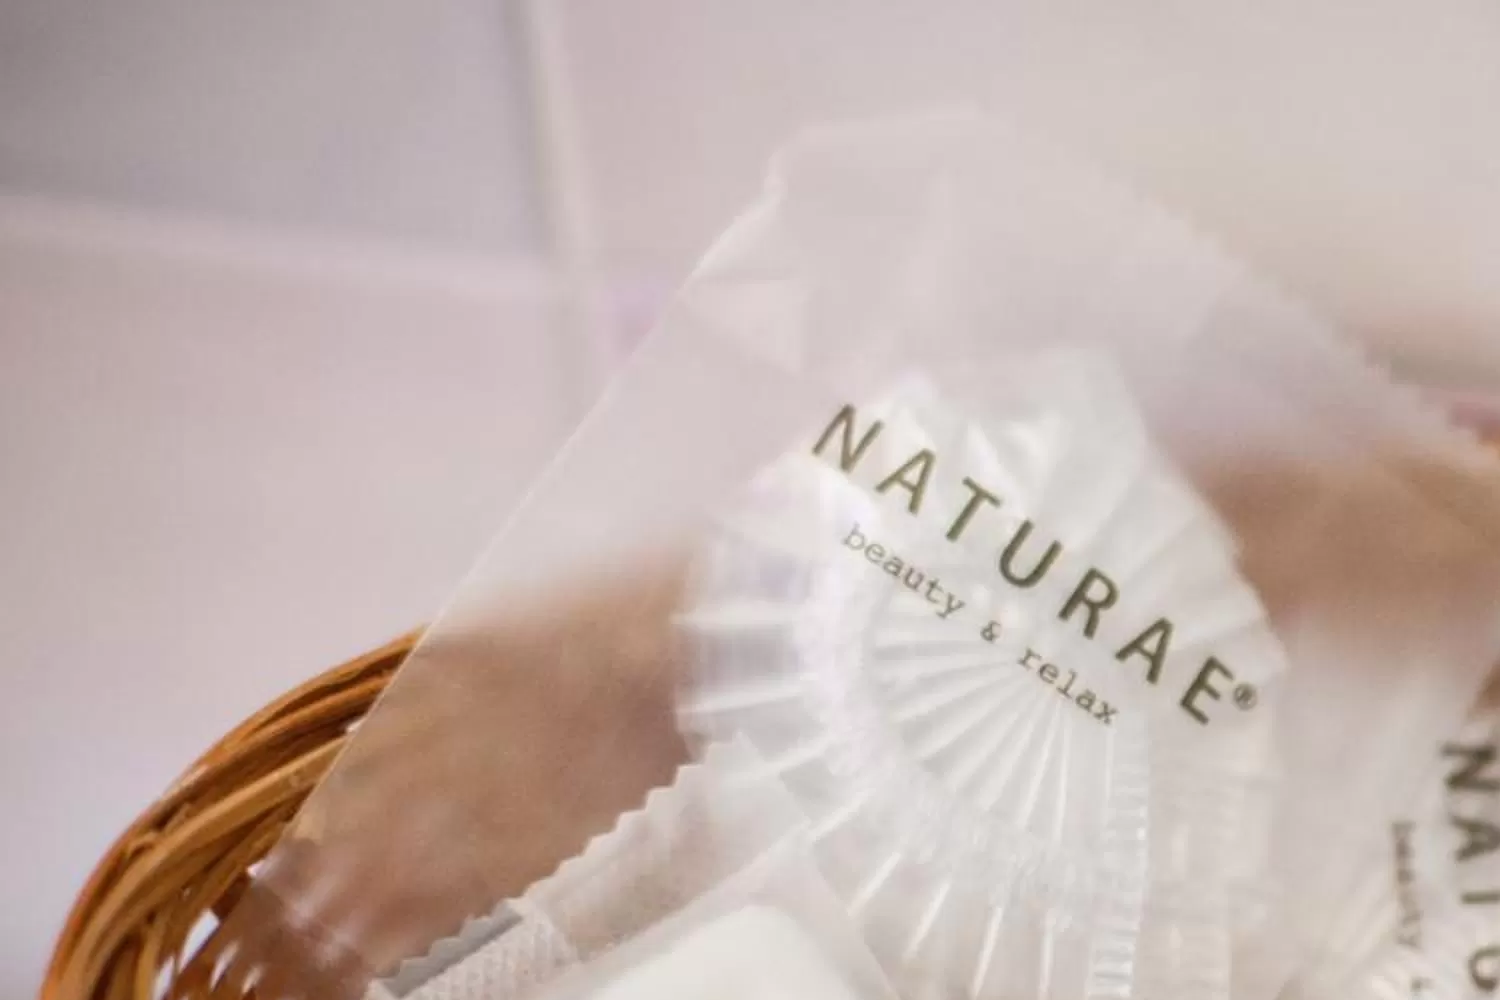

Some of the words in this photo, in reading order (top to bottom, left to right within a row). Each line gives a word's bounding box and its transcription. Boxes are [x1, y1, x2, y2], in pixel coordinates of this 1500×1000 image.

[841, 522, 966, 619] beauty
[979, 621, 1003, 643] &
[1016, 645, 1120, 725] relax
